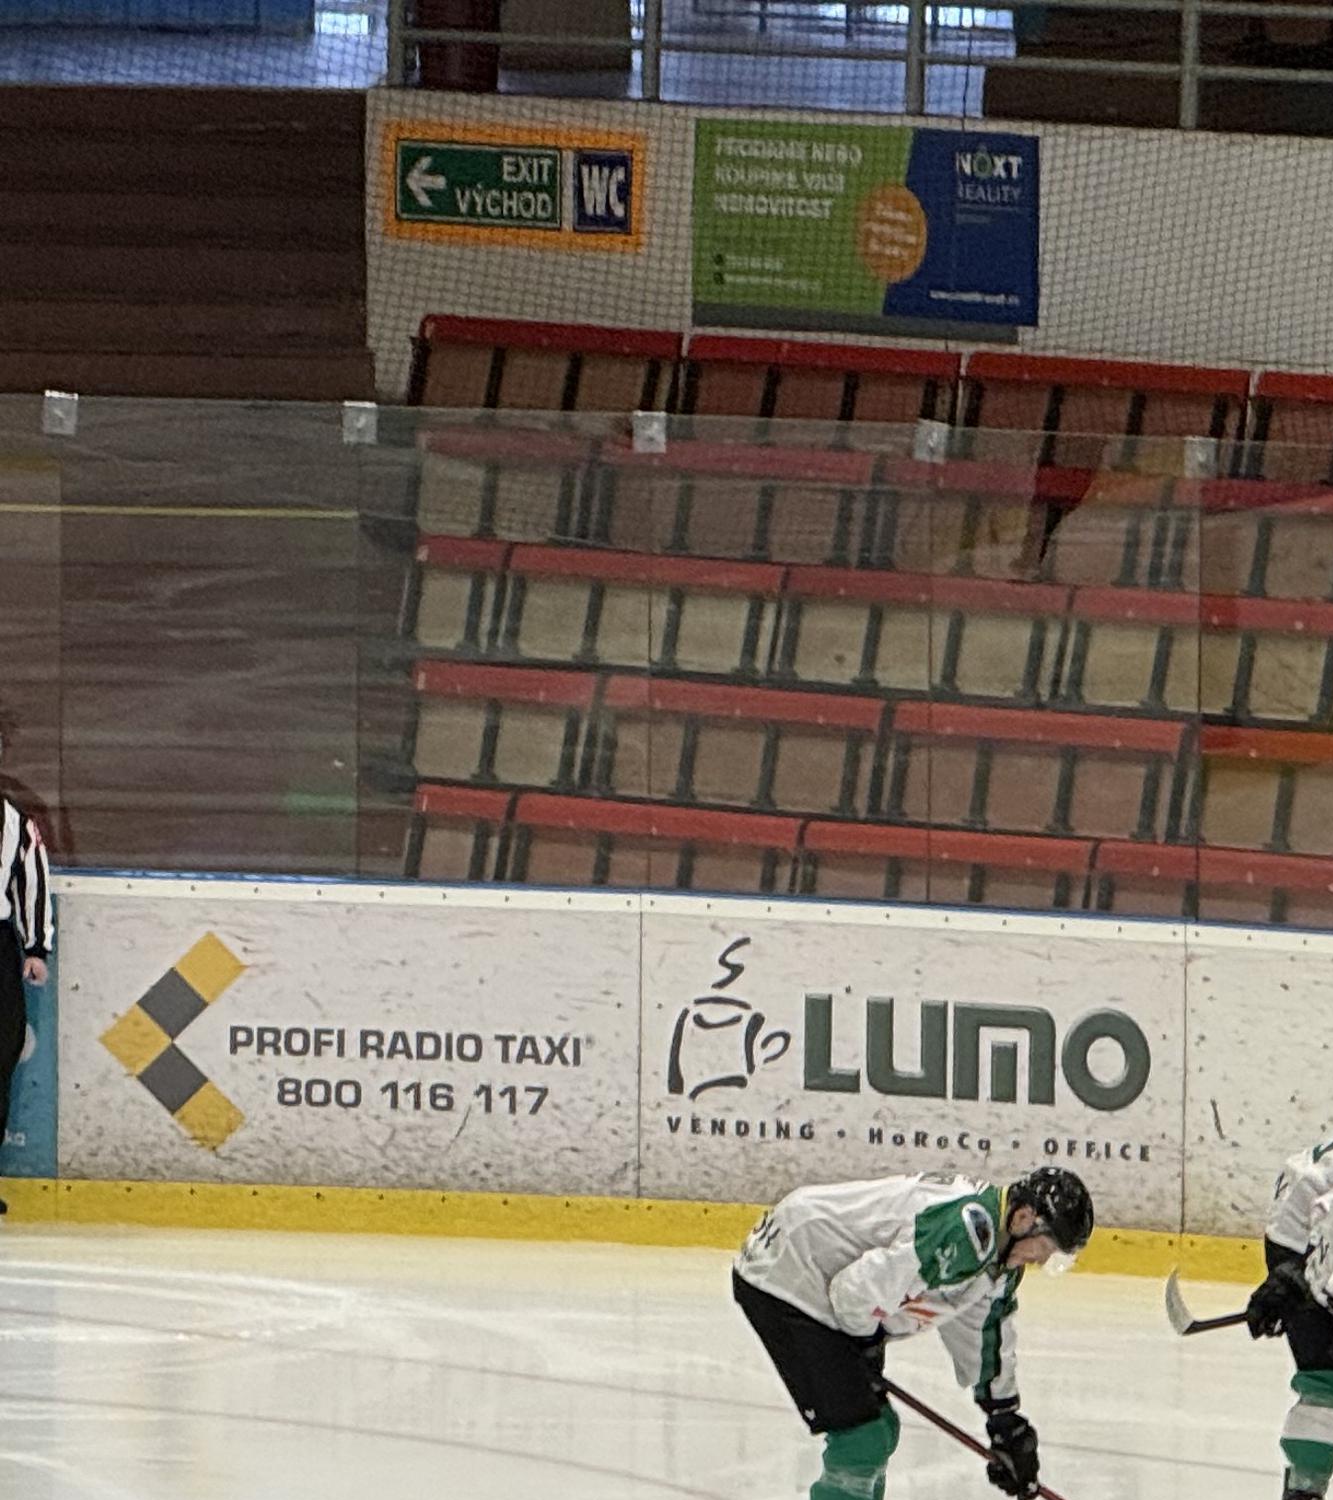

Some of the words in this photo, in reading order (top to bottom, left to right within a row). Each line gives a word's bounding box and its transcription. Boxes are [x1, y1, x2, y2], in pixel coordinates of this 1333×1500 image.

[502, 155, 553, 185] EXIT
[580, 163, 627, 218] WC
[454, 182, 552, 219] VÝCHOD
[229, 1024, 345, 1058] PROFI
[359, 1028, 483, 1063] RADIO
[494, 1033, 581, 1067] TAXI
[277, 1076, 362, 1109] 800
[379, 1079, 455, 1112] 116
[473, 1083, 549, 1116] 117
[666, 1115, 816, 1141] VENDING
[1043, 1136, 1151, 1163] OFFICE
